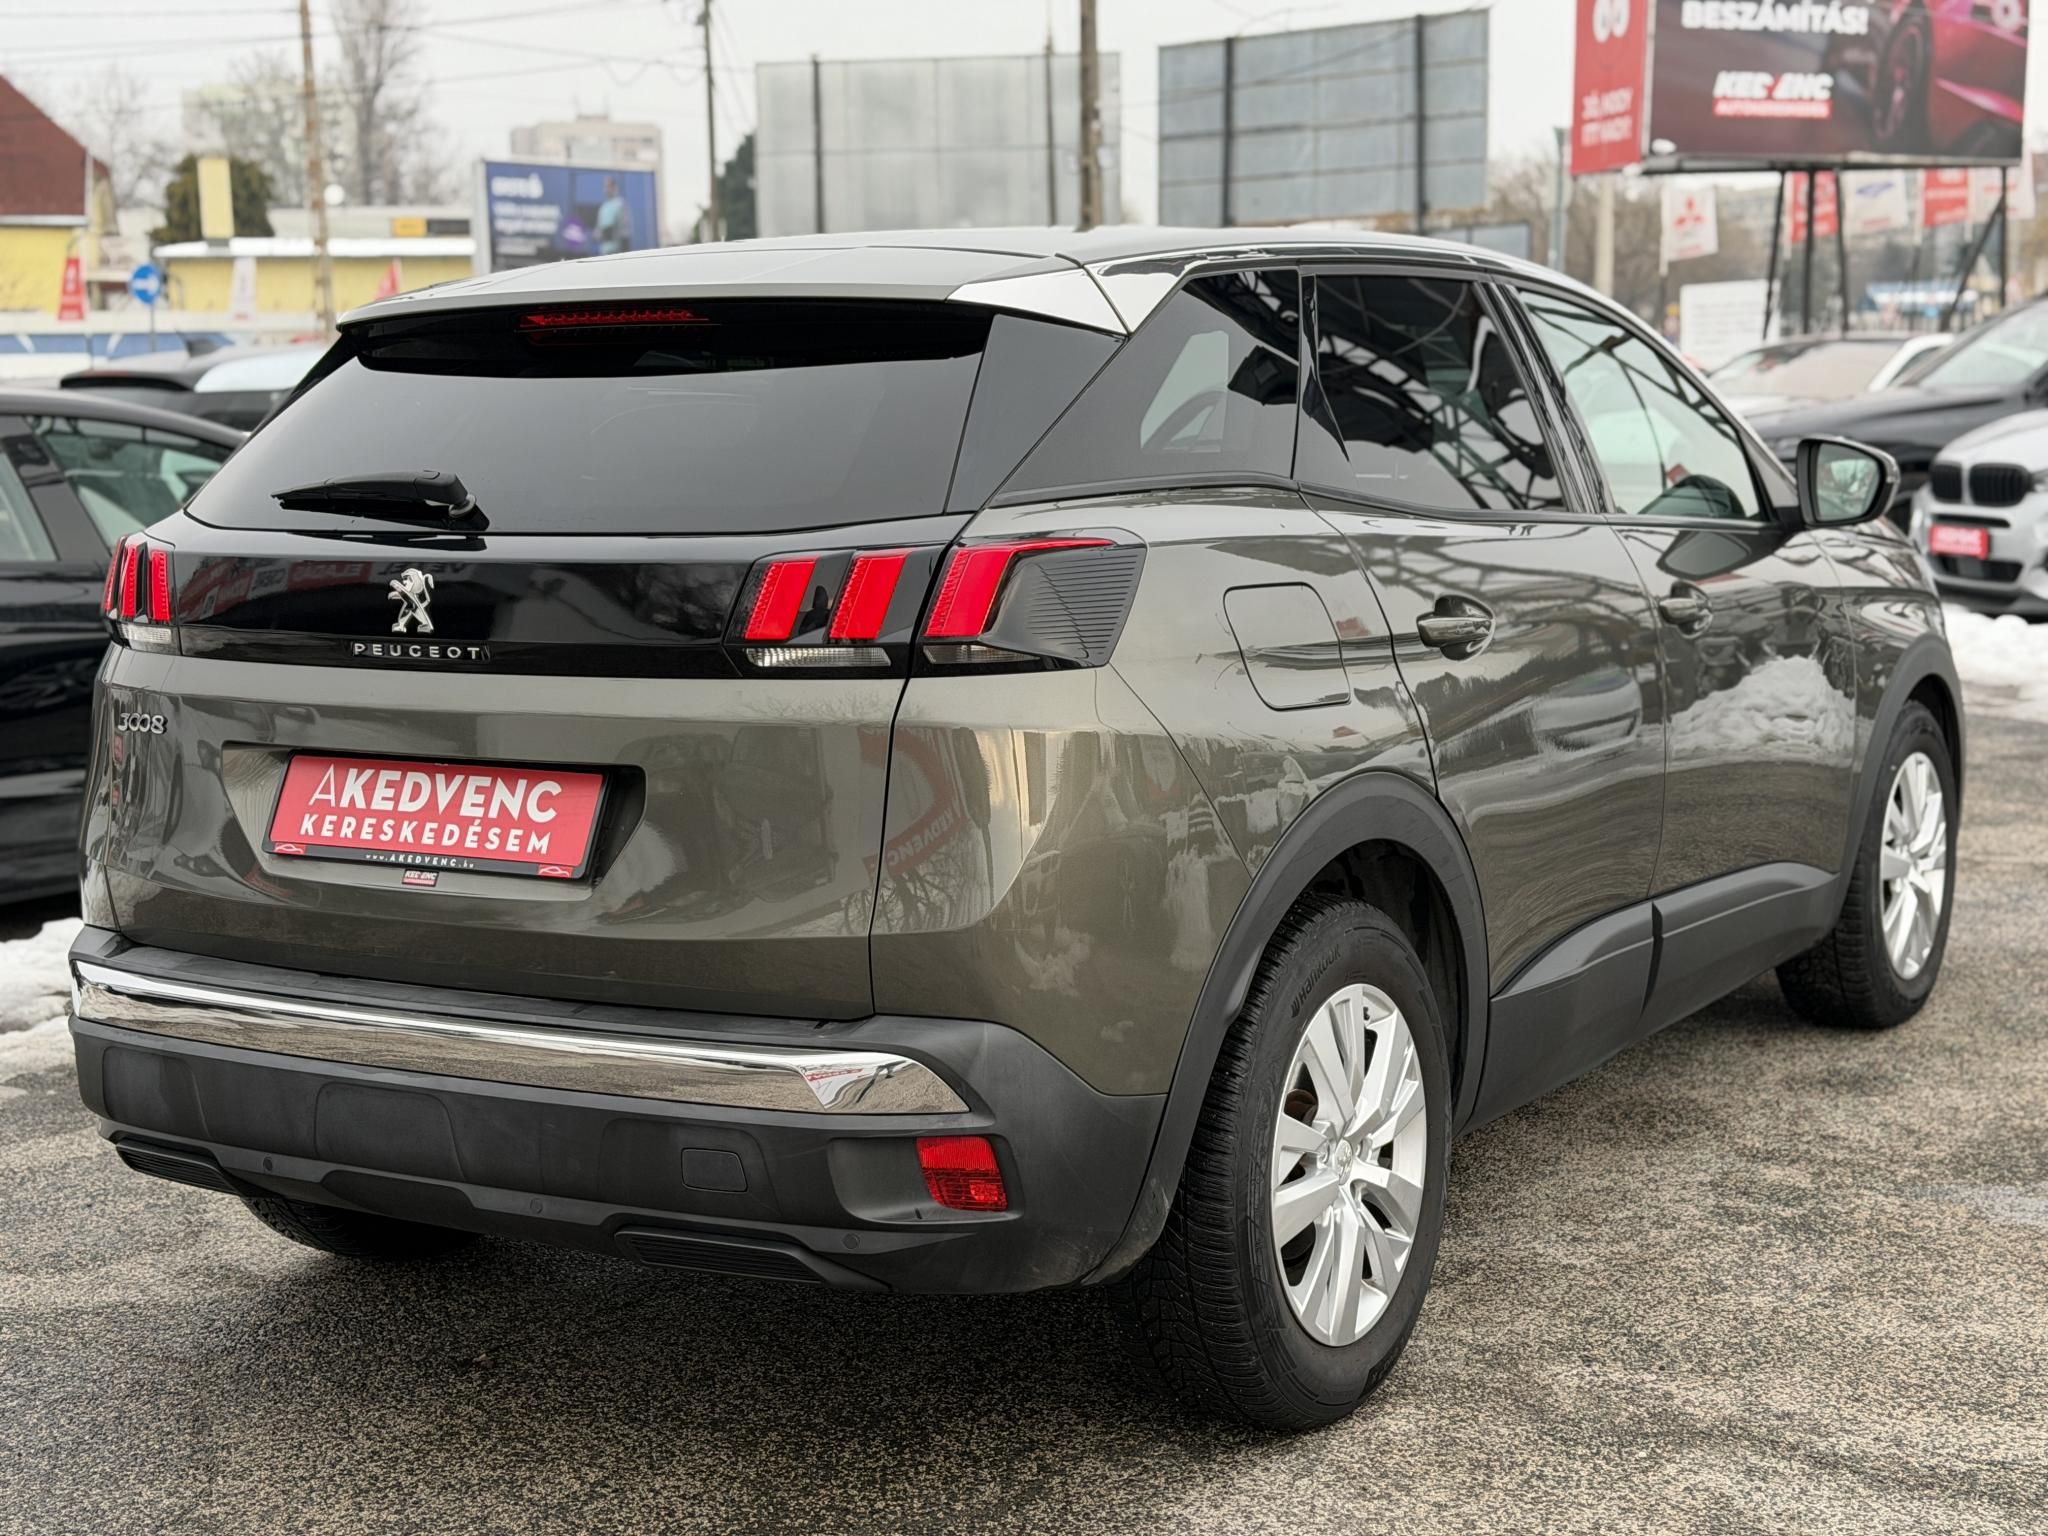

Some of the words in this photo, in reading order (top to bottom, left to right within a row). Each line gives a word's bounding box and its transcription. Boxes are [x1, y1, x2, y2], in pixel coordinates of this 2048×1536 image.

[354, 642, 481, 661] PEUGEOT
[117, 712, 168, 735] 3008
[308, 763, 562, 823] AKEDVENC
[299, 813, 551, 855] KERESKEDÉSEM
[365, 853, 474, 869] www.AKEDVENC.hu
